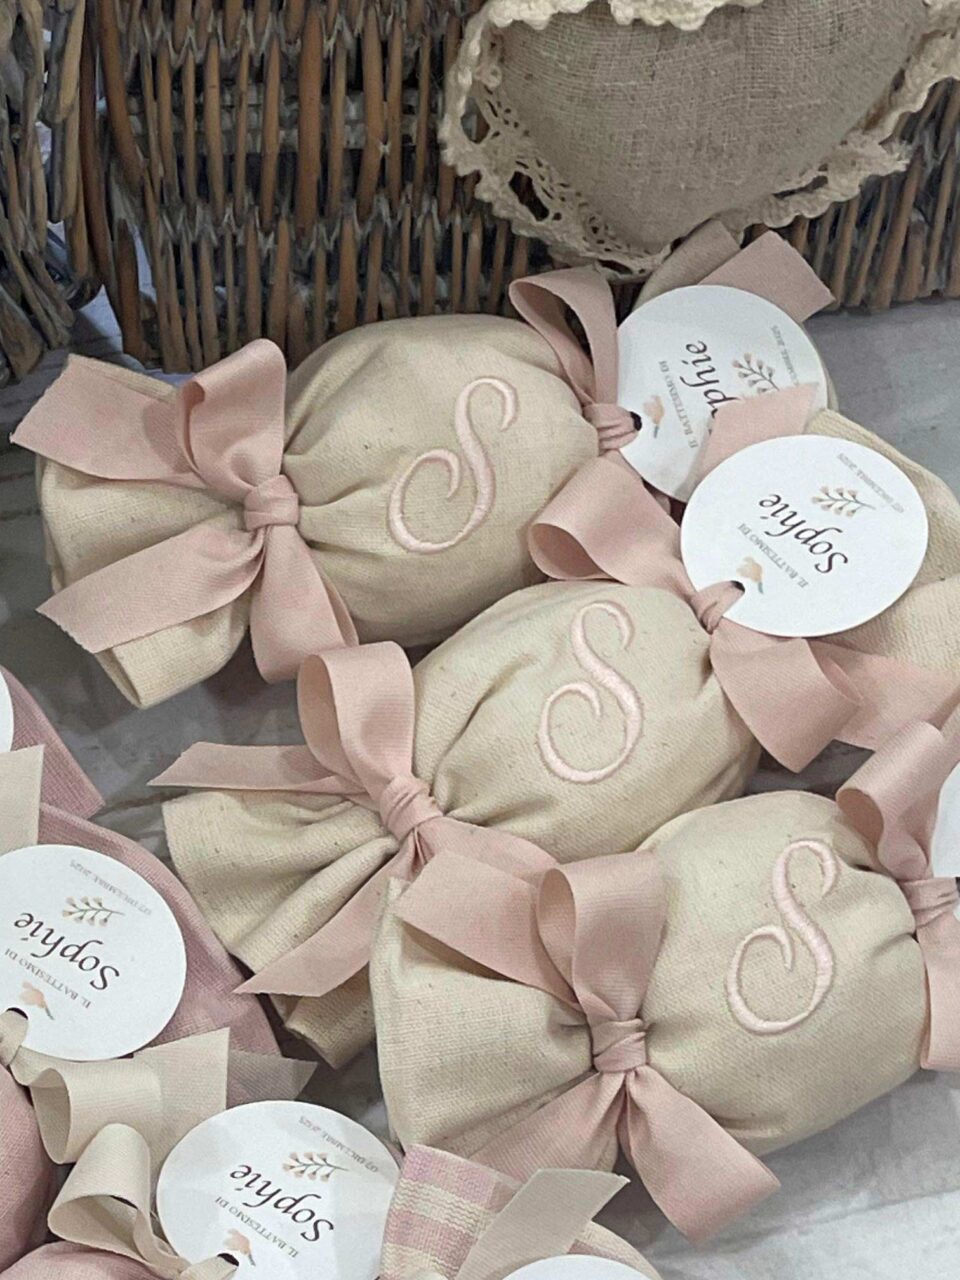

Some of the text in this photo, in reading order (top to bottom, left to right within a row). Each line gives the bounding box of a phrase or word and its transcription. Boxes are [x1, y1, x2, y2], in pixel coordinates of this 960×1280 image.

[680, 340, 739, 418] phie
[388, 376, 518, 554] S
[758, 493, 848, 574] Sophie
[538, 601, 641, 783] S
[5, 948, 18, 960] DI
[14, 913, 119, 990] Sophie
[727, 838, 837, 1036] S
[20, 958, 78, 1001] BATTESIMO
[215, 1196, 229, 1210] DI
[229, 1164, 333, 1242] Sophie
[229, 1206, 286, 1250] BATTESIMO
